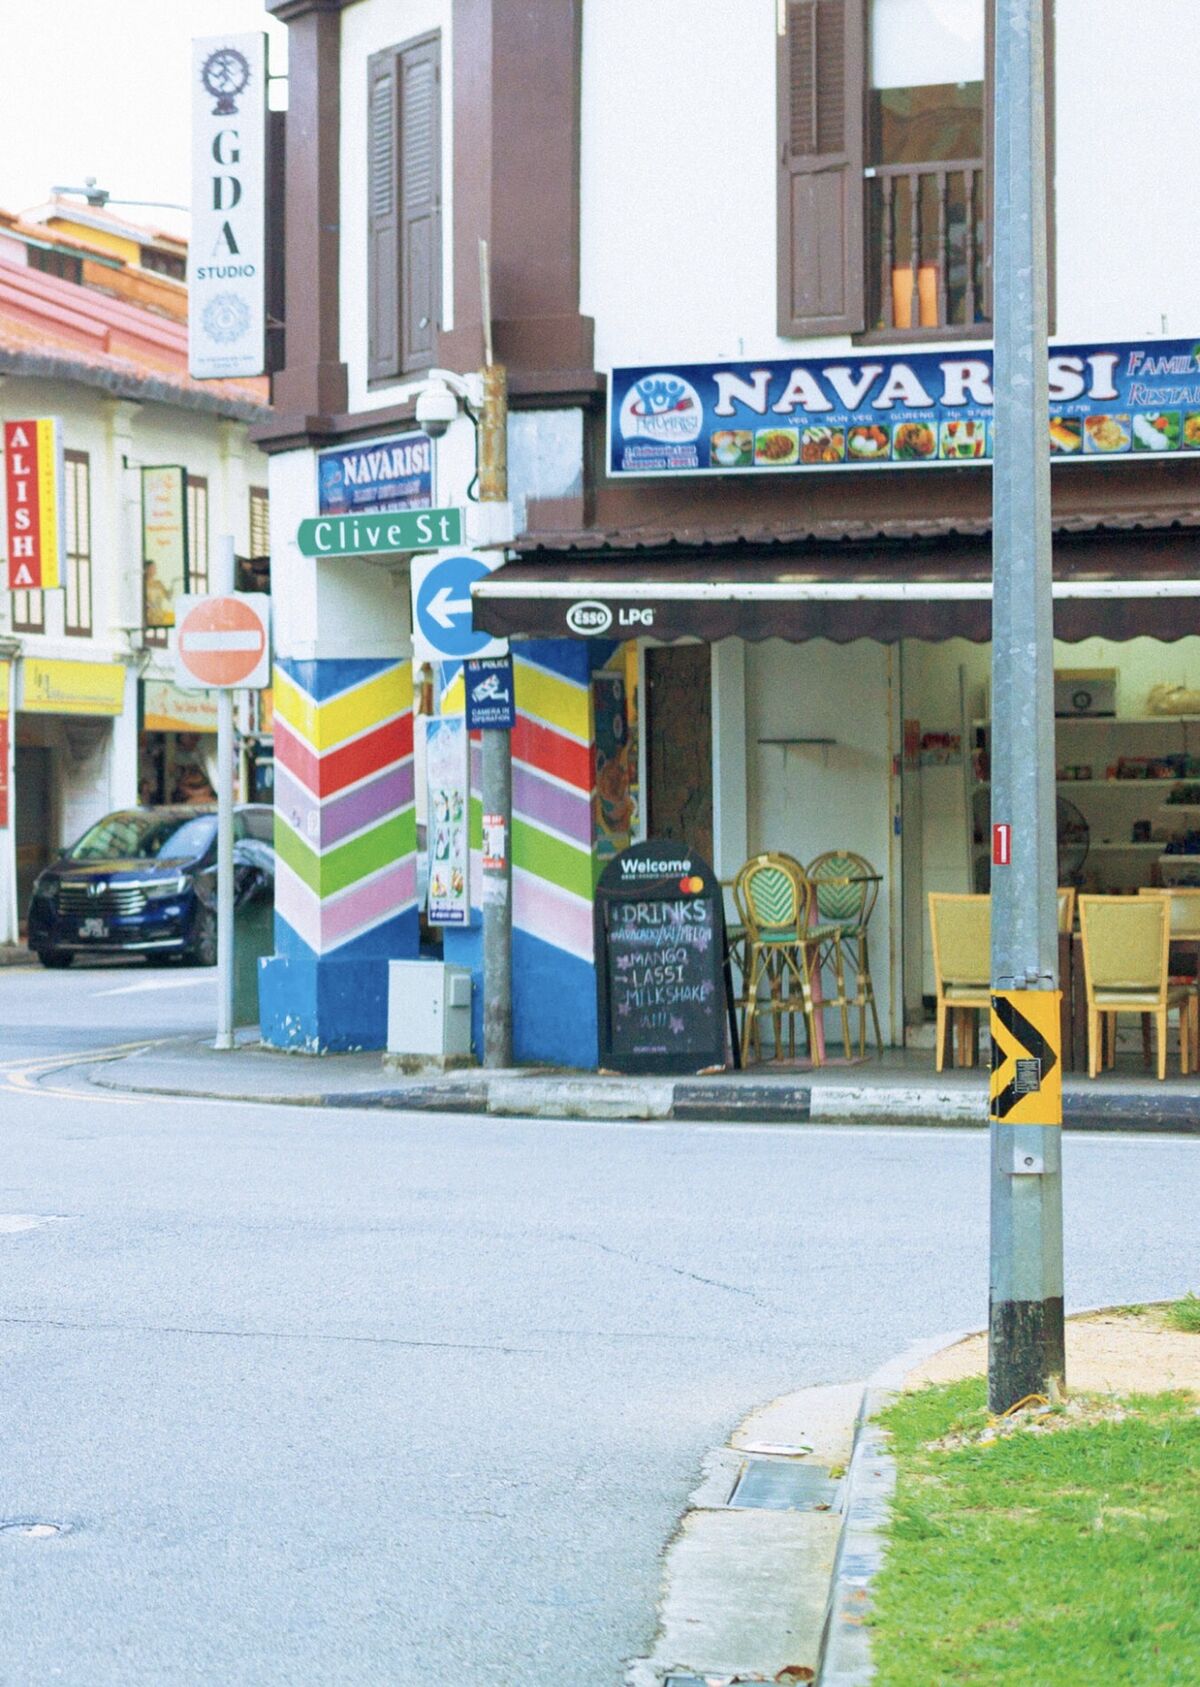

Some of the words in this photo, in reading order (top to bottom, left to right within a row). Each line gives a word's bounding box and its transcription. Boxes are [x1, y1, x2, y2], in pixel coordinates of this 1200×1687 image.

[211, 129, 242, 257] GDA
[197, 264, 255, 280] STUDIO
[711, 351, 1120, 418] NAVARSI
[342, 442, 430, 486] NAVARISI
[10, 426, 34, 585] ALISHA
[314, 520, 402, 551] Clive
[416, 513, 450, 544] St
[574, 608, 606, 626] Esso
[618, 607, 654, 626] LPG
[997, 826, 1007, 863] 1
[620, 858, 692, 874] Welcome
[622, 899, 707, 924] DRINKS
[629, 947, 688, 967] MANGO
[632, 964, 685, 988] LASSI
[625, 984, 706, 1007] MILKSHAKE
